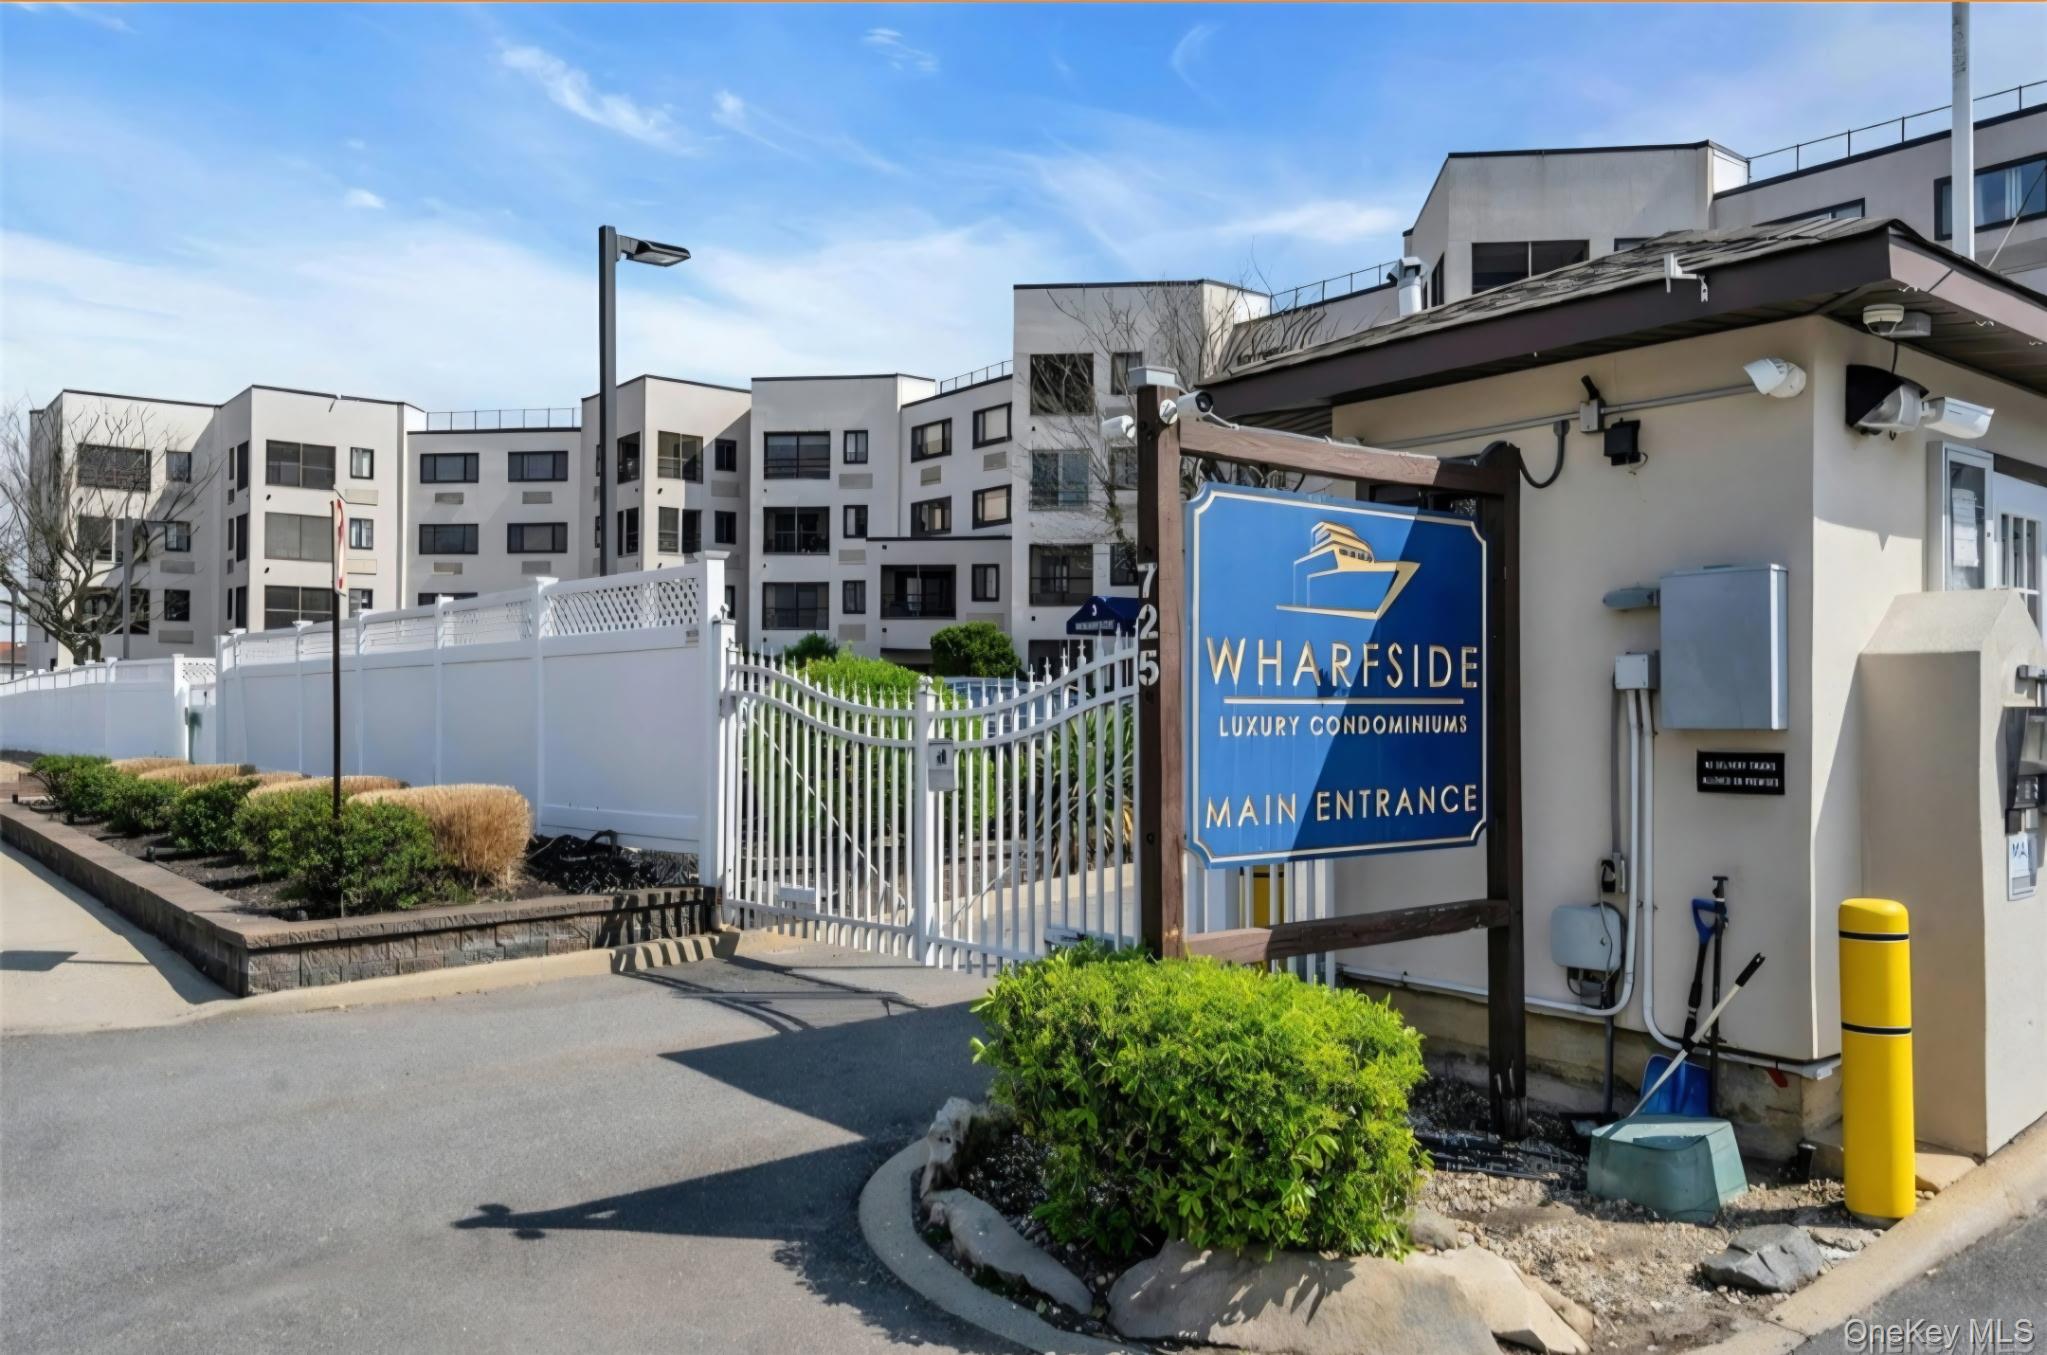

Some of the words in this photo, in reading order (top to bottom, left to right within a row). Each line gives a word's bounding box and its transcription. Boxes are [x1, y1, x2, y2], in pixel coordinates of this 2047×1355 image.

[1137, 562, 1159, 686] 725
[1206, 637, 1478, 689] WHARFSIDE
[1219, 715, 1299, 737] LUXURY
[1310, 715, 1467, 735] CONDOMINIUMS
[1205, 793, 1297, 828] MAIN
[1316, 784, 1477, 821] ENTRANCE
